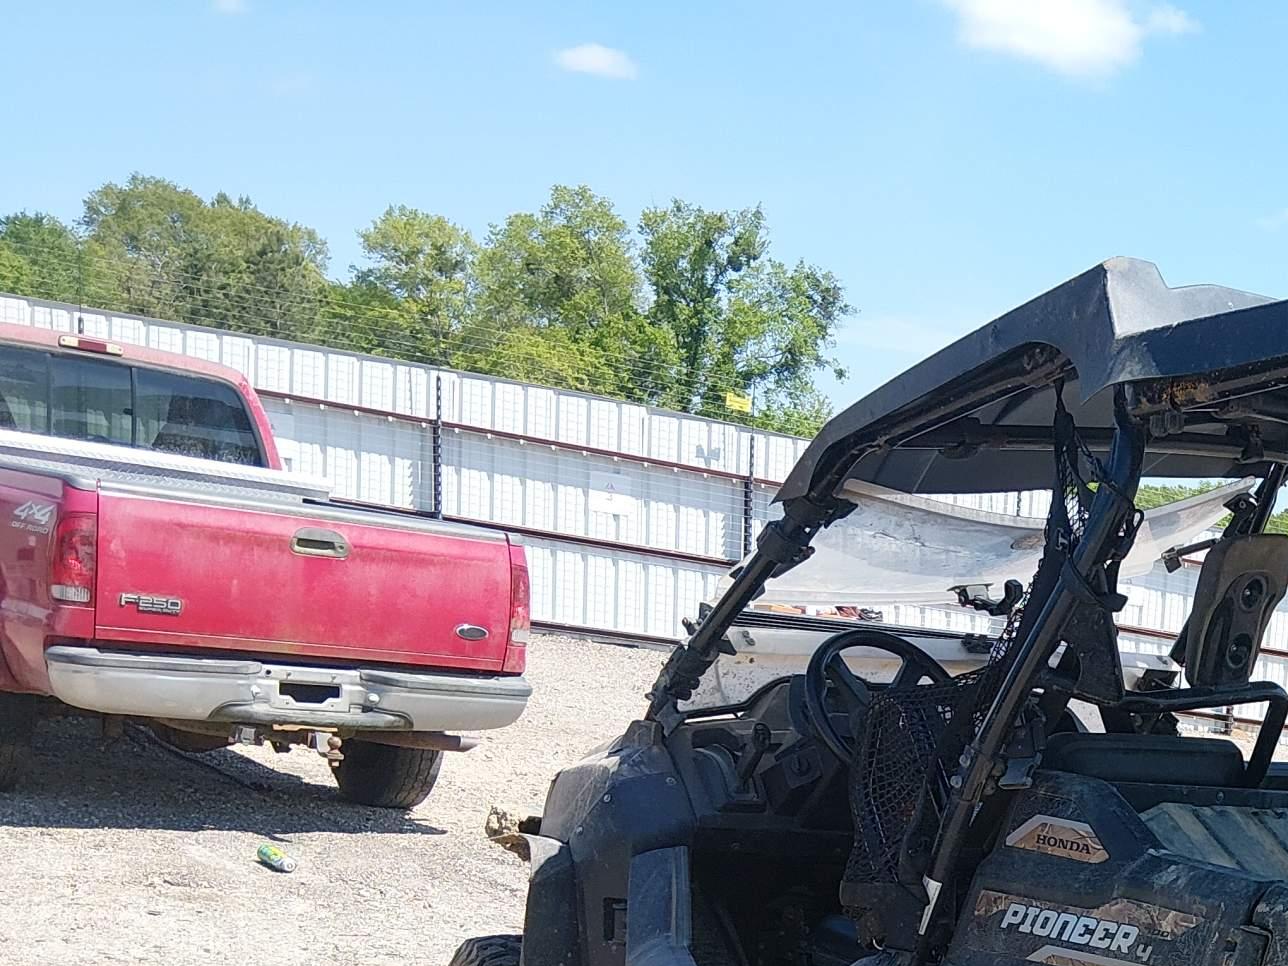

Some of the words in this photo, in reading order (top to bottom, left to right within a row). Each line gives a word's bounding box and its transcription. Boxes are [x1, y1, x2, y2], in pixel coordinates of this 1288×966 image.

[1036, 834, 1091, 854] HONDA
[1000, 903, 1139, 954] PIONEER
[1136, 943, 1152, 961] 4
